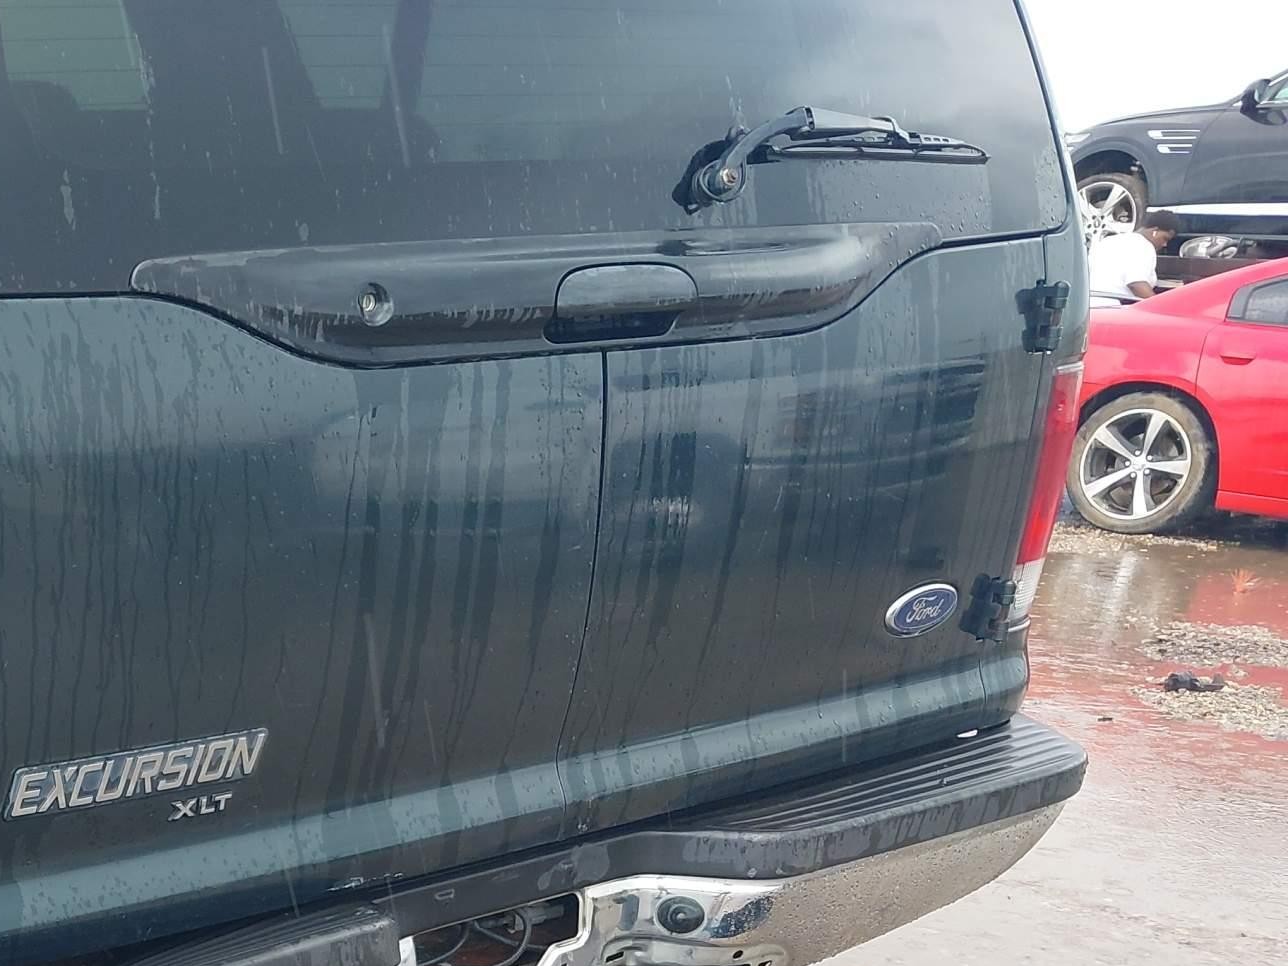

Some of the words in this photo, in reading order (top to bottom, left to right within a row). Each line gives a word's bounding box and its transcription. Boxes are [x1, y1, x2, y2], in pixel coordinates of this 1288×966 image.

[905, 595, 945, 623] Ford
[11, 732, 266, 818] EXCURSION
[167, 791, 233, 821] XLT
